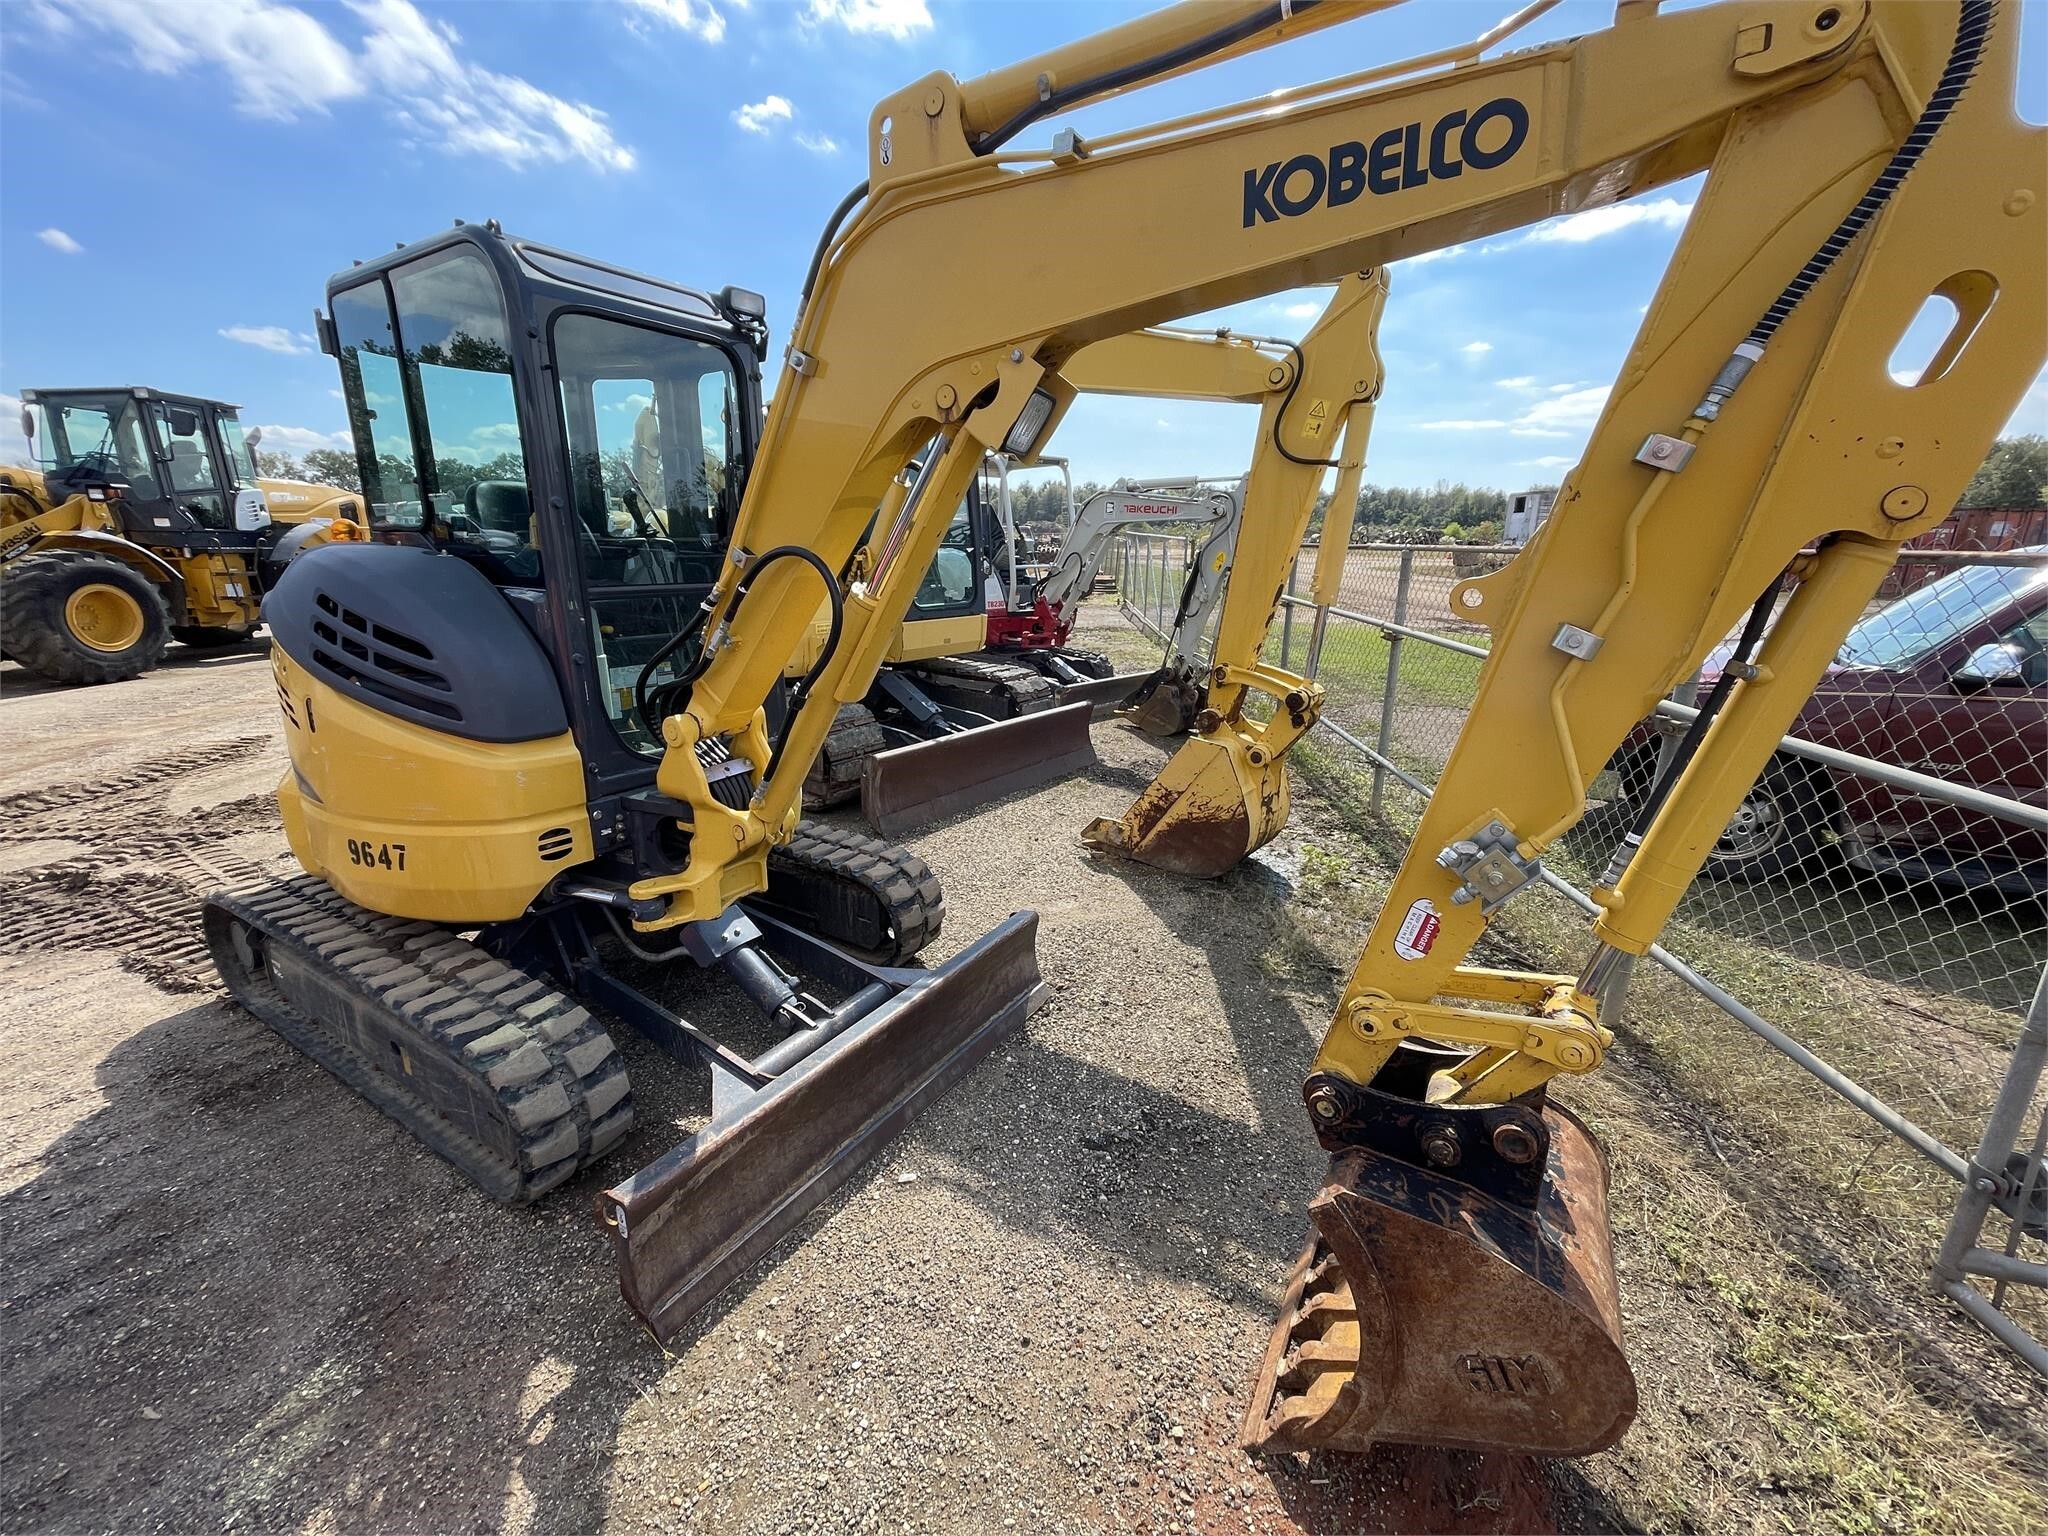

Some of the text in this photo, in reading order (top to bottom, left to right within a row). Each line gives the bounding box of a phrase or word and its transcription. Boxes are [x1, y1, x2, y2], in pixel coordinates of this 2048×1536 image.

[1243, 97, 1530, 228] KOBELCO
[347, 838, 406, 871] 9647
[1416, 924, 1435, 951] DANGER
